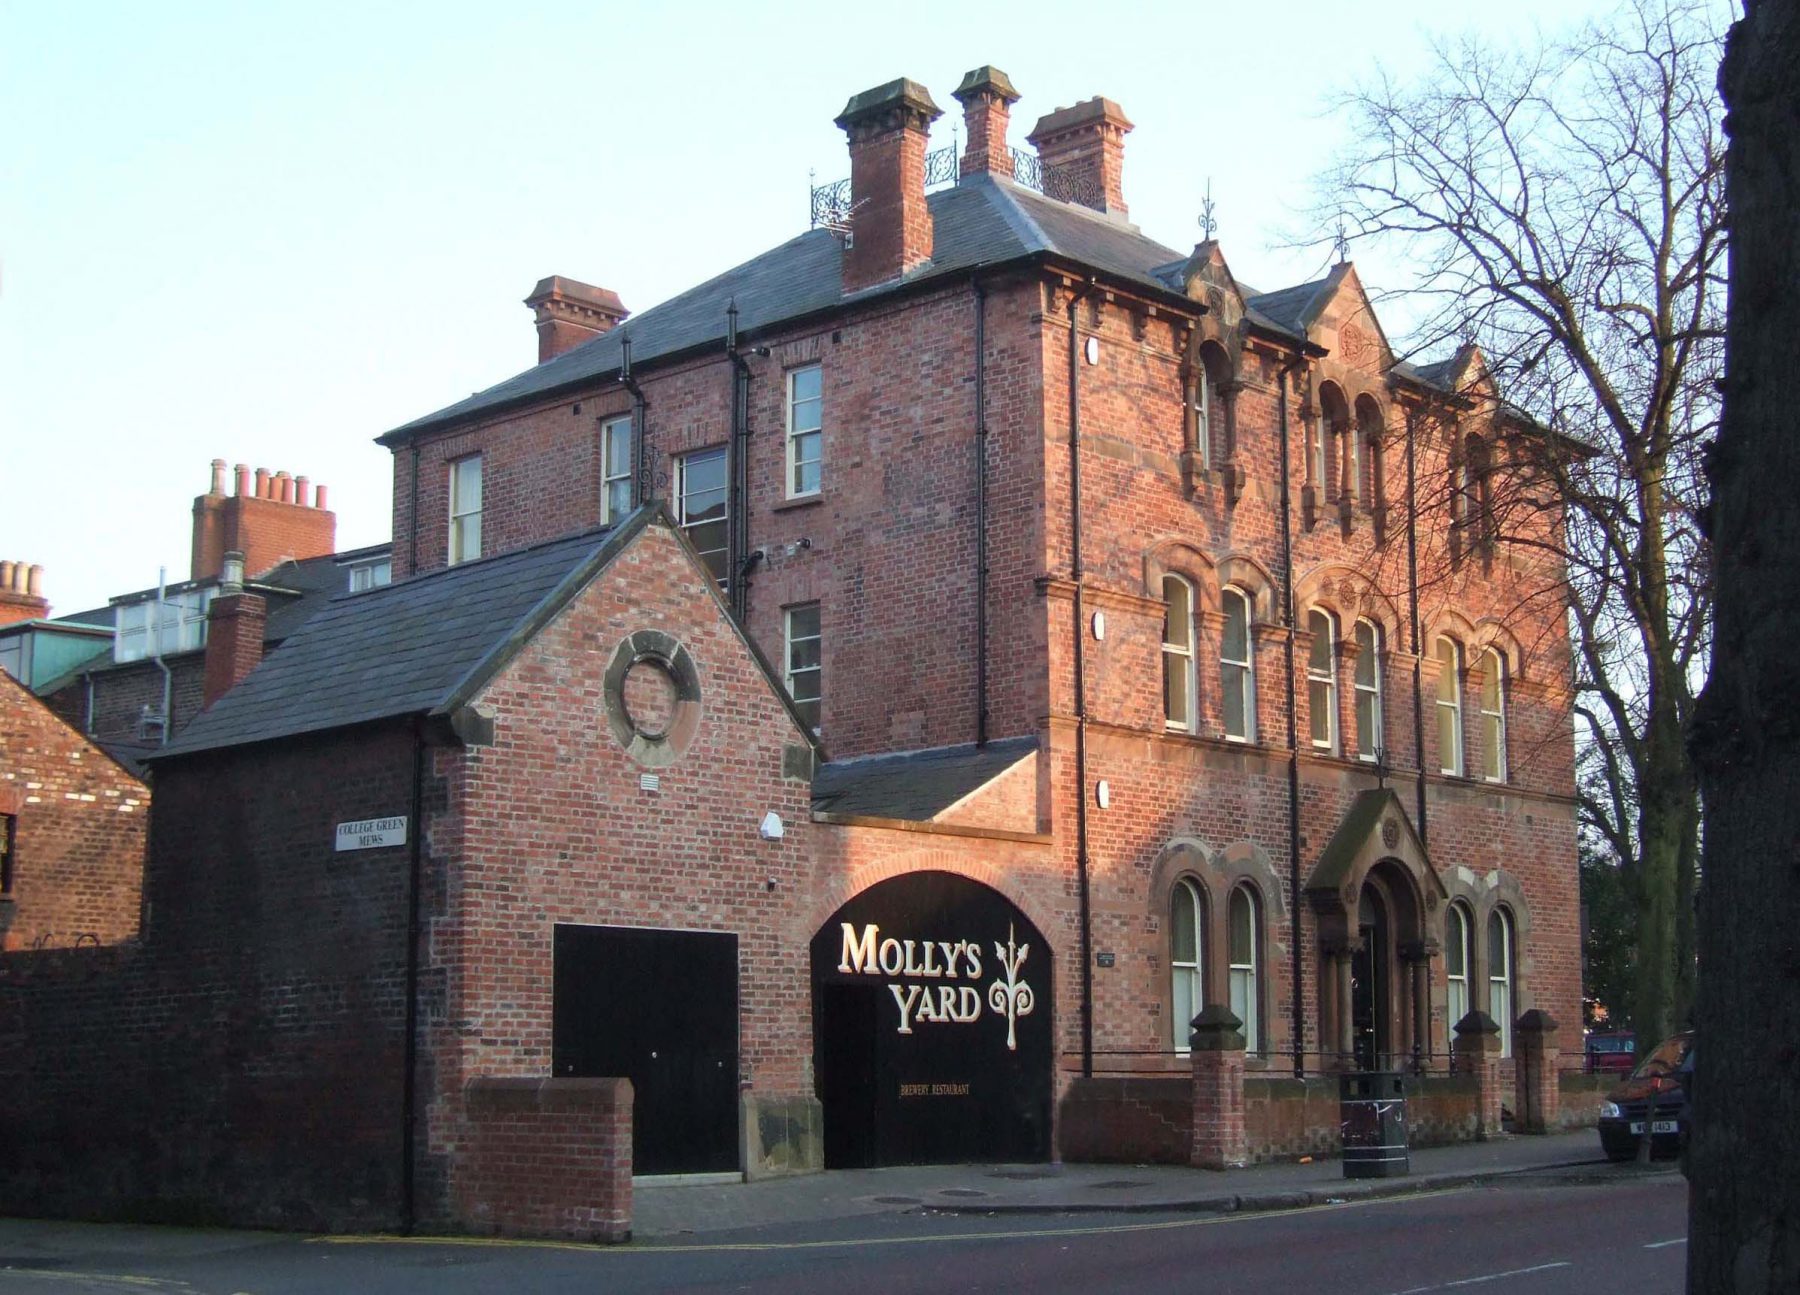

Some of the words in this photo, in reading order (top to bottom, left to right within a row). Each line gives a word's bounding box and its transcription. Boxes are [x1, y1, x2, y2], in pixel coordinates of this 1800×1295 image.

[338, 821, 375, 836] COLLEGE
[376, 817, 404, 831] GREEN
[358, 834, 384, 847] MEWS
[837, 922, 983, 980] MOLLY'S
[888, 984, 982, 1035] YARD
[900, 1083, 929, 1096] BREWERY
[932, 1083, 969, 1095] RESTAURANT
